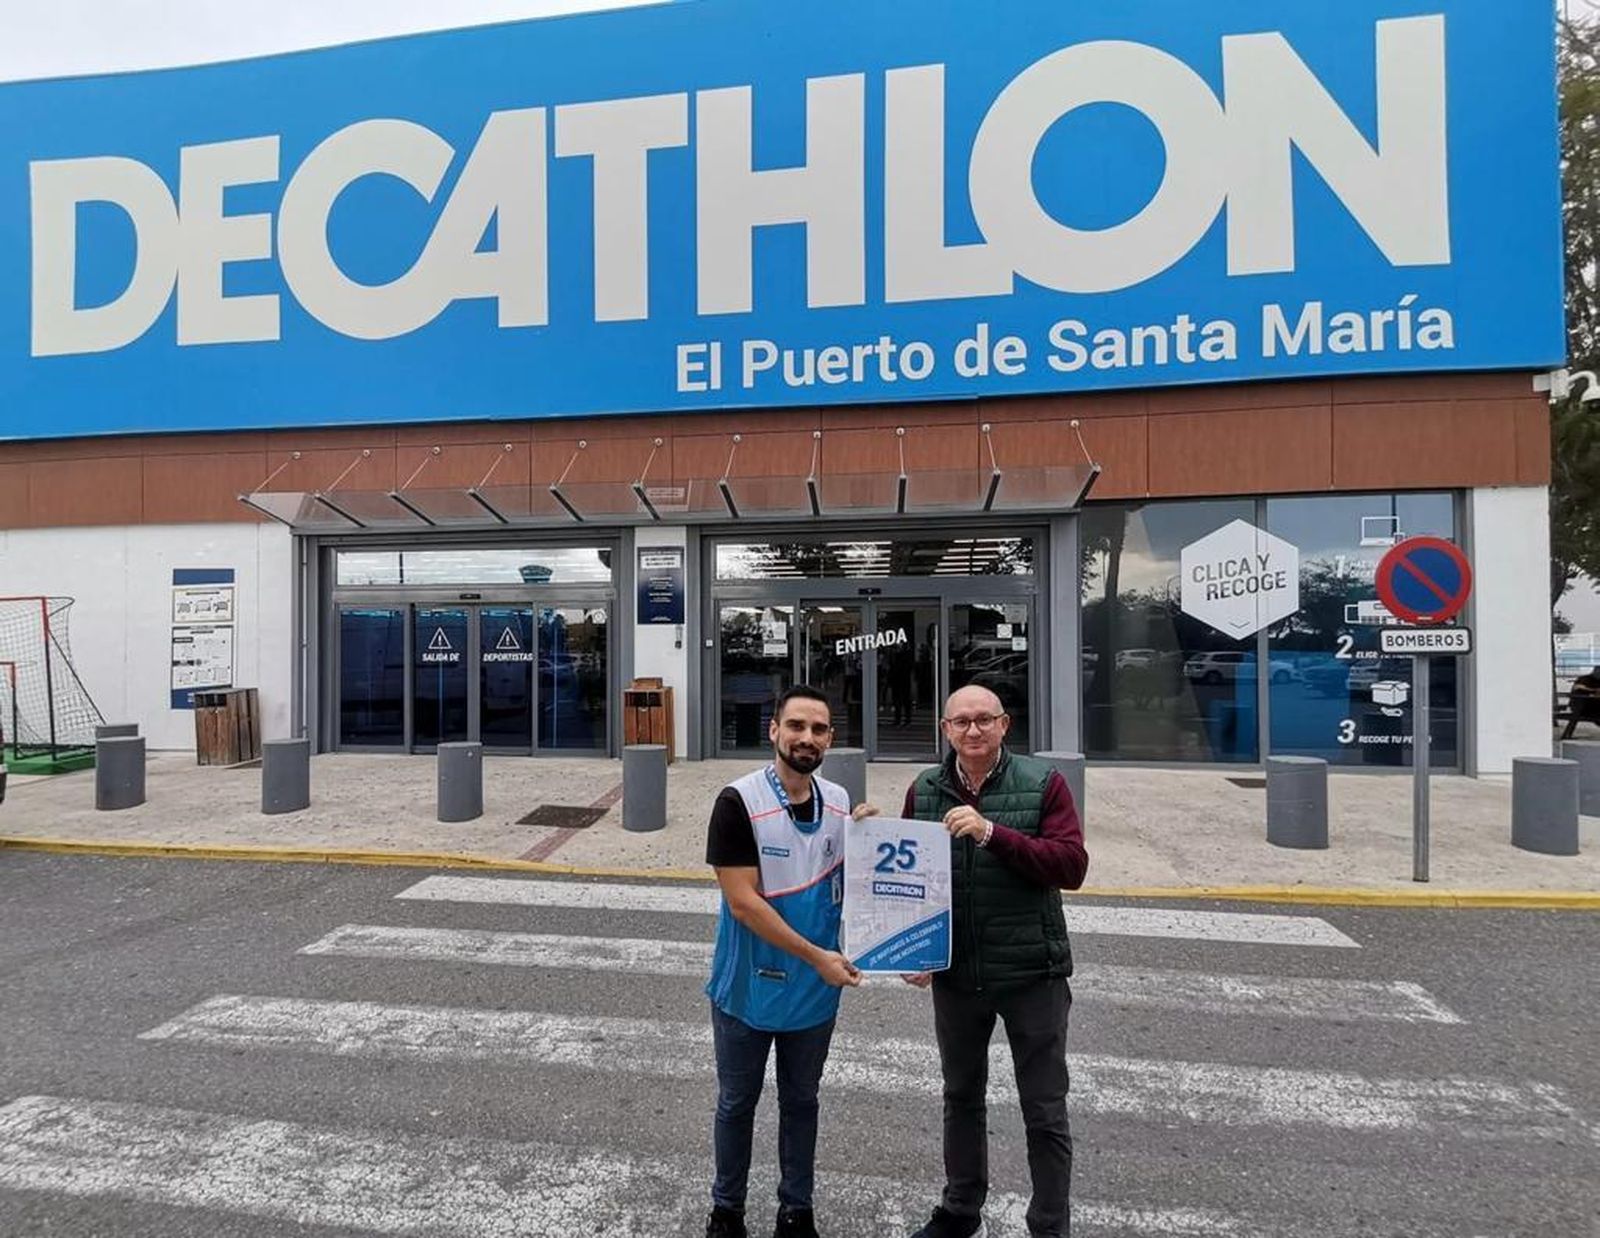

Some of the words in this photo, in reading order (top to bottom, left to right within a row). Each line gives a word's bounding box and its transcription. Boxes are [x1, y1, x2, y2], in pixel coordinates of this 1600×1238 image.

[29, 13, 1451, 357] DECATHLON
[677, 342, 721, 392] El
[743, 335, 934, 389] Puerto
[954, 323, 1027, 377] de
[1048, 314, 1237, 371] Santa
[1262, 294, 1454, 357] María
[1192, 557, 1252, 583] CLICA
[1256, 553, 1270, 571] Y
[1206, 570, 1287, 601] RECOGE
[835, 627, 908, 656] ENTRADA
[1335, 635, 1354, 659] 2
[1386, 634, 1464, 647] BOMBEROS
[422, 653, 449, 661] SALIDA
[449, 653, 460, 661] DE
[483, 653, 533, 661] DEPORTISTAS
[1337, 720, 1355, 743] 3
[1359, 735, 1389, 744] RECOGE
[874, 839, 918, 873] 25
[875, 883, 924, 896] DECATHLON
